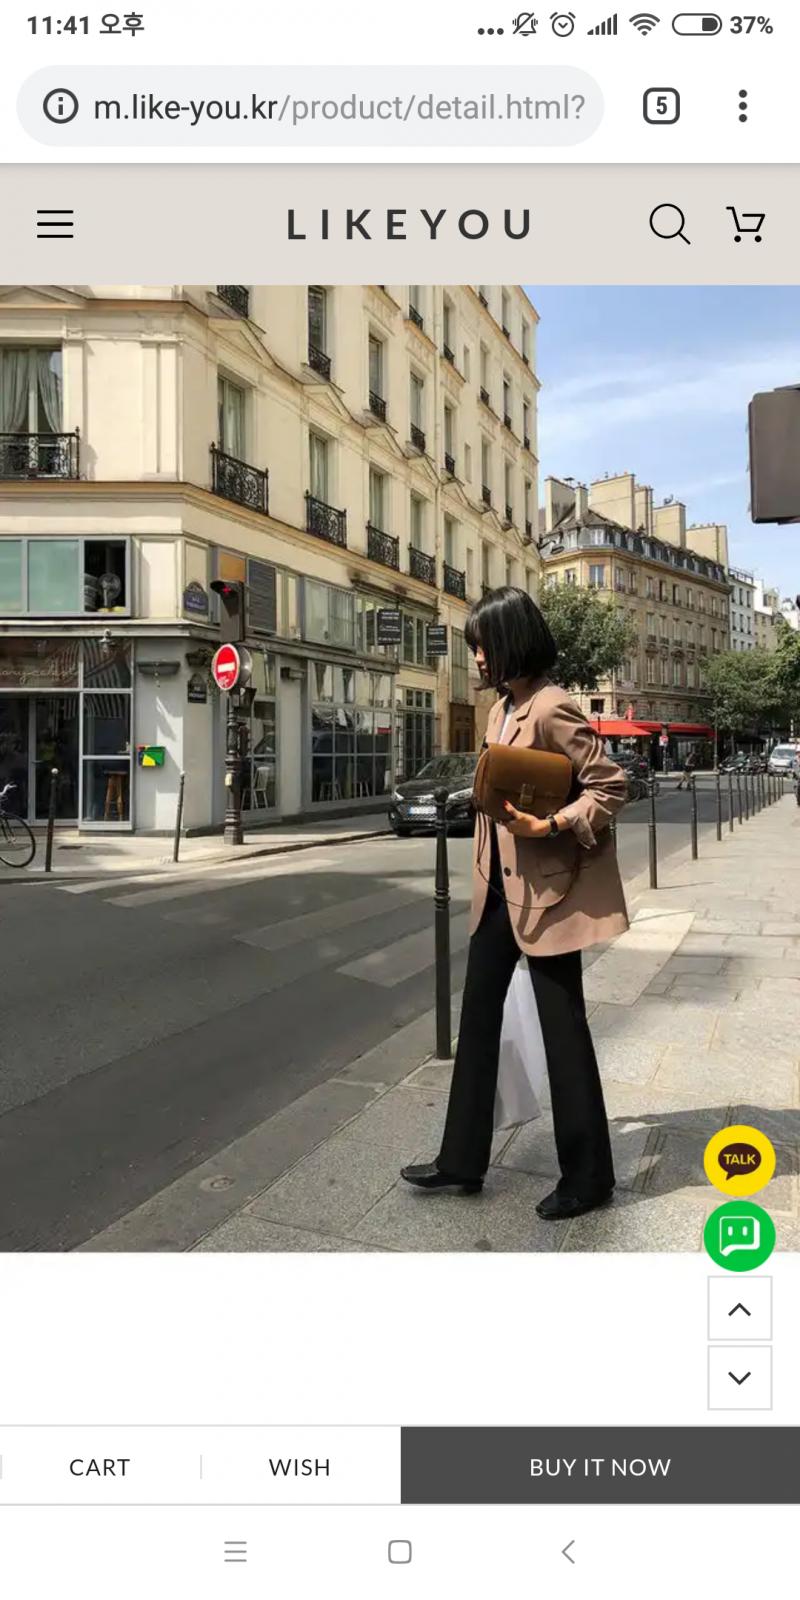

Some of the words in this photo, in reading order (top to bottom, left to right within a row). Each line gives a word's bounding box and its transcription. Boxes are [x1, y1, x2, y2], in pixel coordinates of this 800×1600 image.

[26, 15, 90, 35] 11:41
[98, 11, 146, 38] 오후
[729, 15, 774, 35] 37%
[93, 92, 586, 127] m.like-you.kr/product/detail.html?
[655, 95, 668, 116] 5
[287, 208, 531, 241] LIKEYOU
[723, 1153, 756, 1165] TALK
[69, 1458, 131, 1477] CART
[268, 1458, 331, 1477] WISH
[530, 1458, 577, 1477] BUY
[584, 1458, 606, 1477] IT
[611, 1458, 672, 1477] NOW
